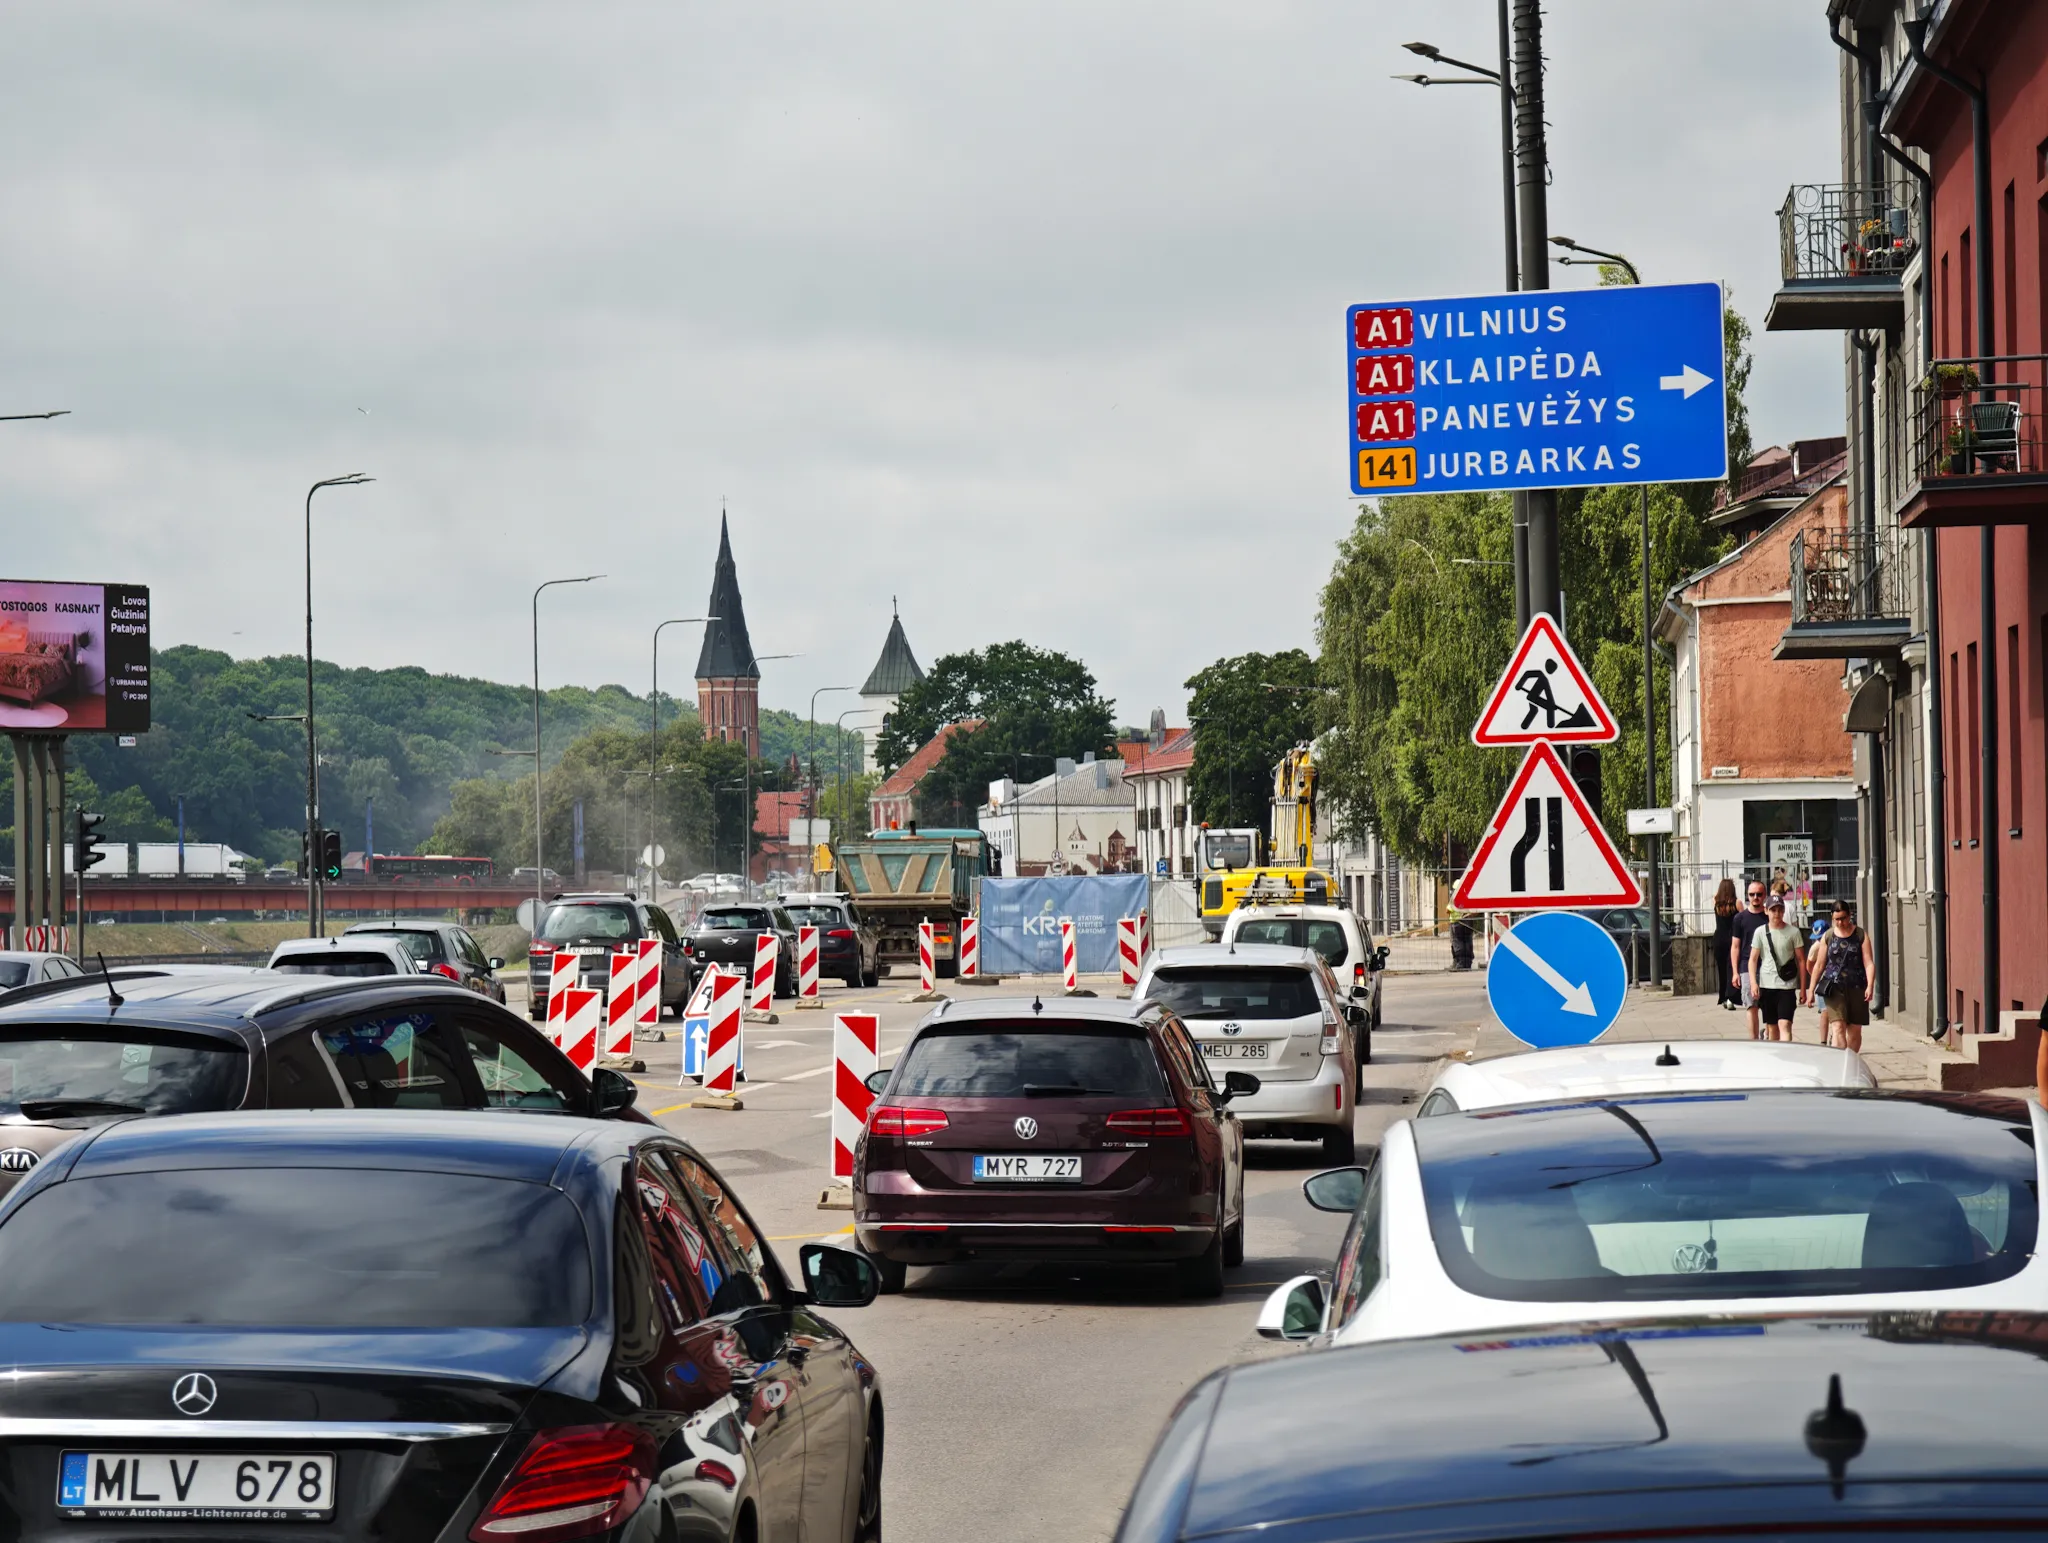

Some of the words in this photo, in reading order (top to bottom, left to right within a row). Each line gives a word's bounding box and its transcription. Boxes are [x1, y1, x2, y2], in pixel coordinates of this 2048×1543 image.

[1367, 315, 1402, 342] A1
[1419, 305, 1567, 339] VILNIUS
[1368, 361, 1403, 388] A1
[1420, 346, 1602, 386] KLAIPĖDA
[1369, 408, 1404, 435] A1
[1421, 389, 1635, 432] PANEVĖŽYS
[1364, 454, 1412, 481] 141
[1423, 443, 1641, 479] JURBARKAS
[55, 602, 100, 614] KASNAKT
[122, 595, 147, 606] Lovos
[111, 606, 147, 620] Čiužiniai
[111, 622, 147, 636] Patalynė
[1777, 843, 1793, 851] ANTRI
[1203, 1044, 1233, 1057] MEU
[1241, 1044, 1265, 1057] 285
[0, 1153, 32, 1169] KIA
[986, 1158, 1028, 1176] MYR
[1042, 1158, 1078, 1176] 727
[63, 1486, 84, 1499] LT
[94, 1458, 200, 1502] MLV
[236, 1460, 322, 1503] 678
[99, 1508, 288, 1519] www.Autohaus-Lichtenrade.de
